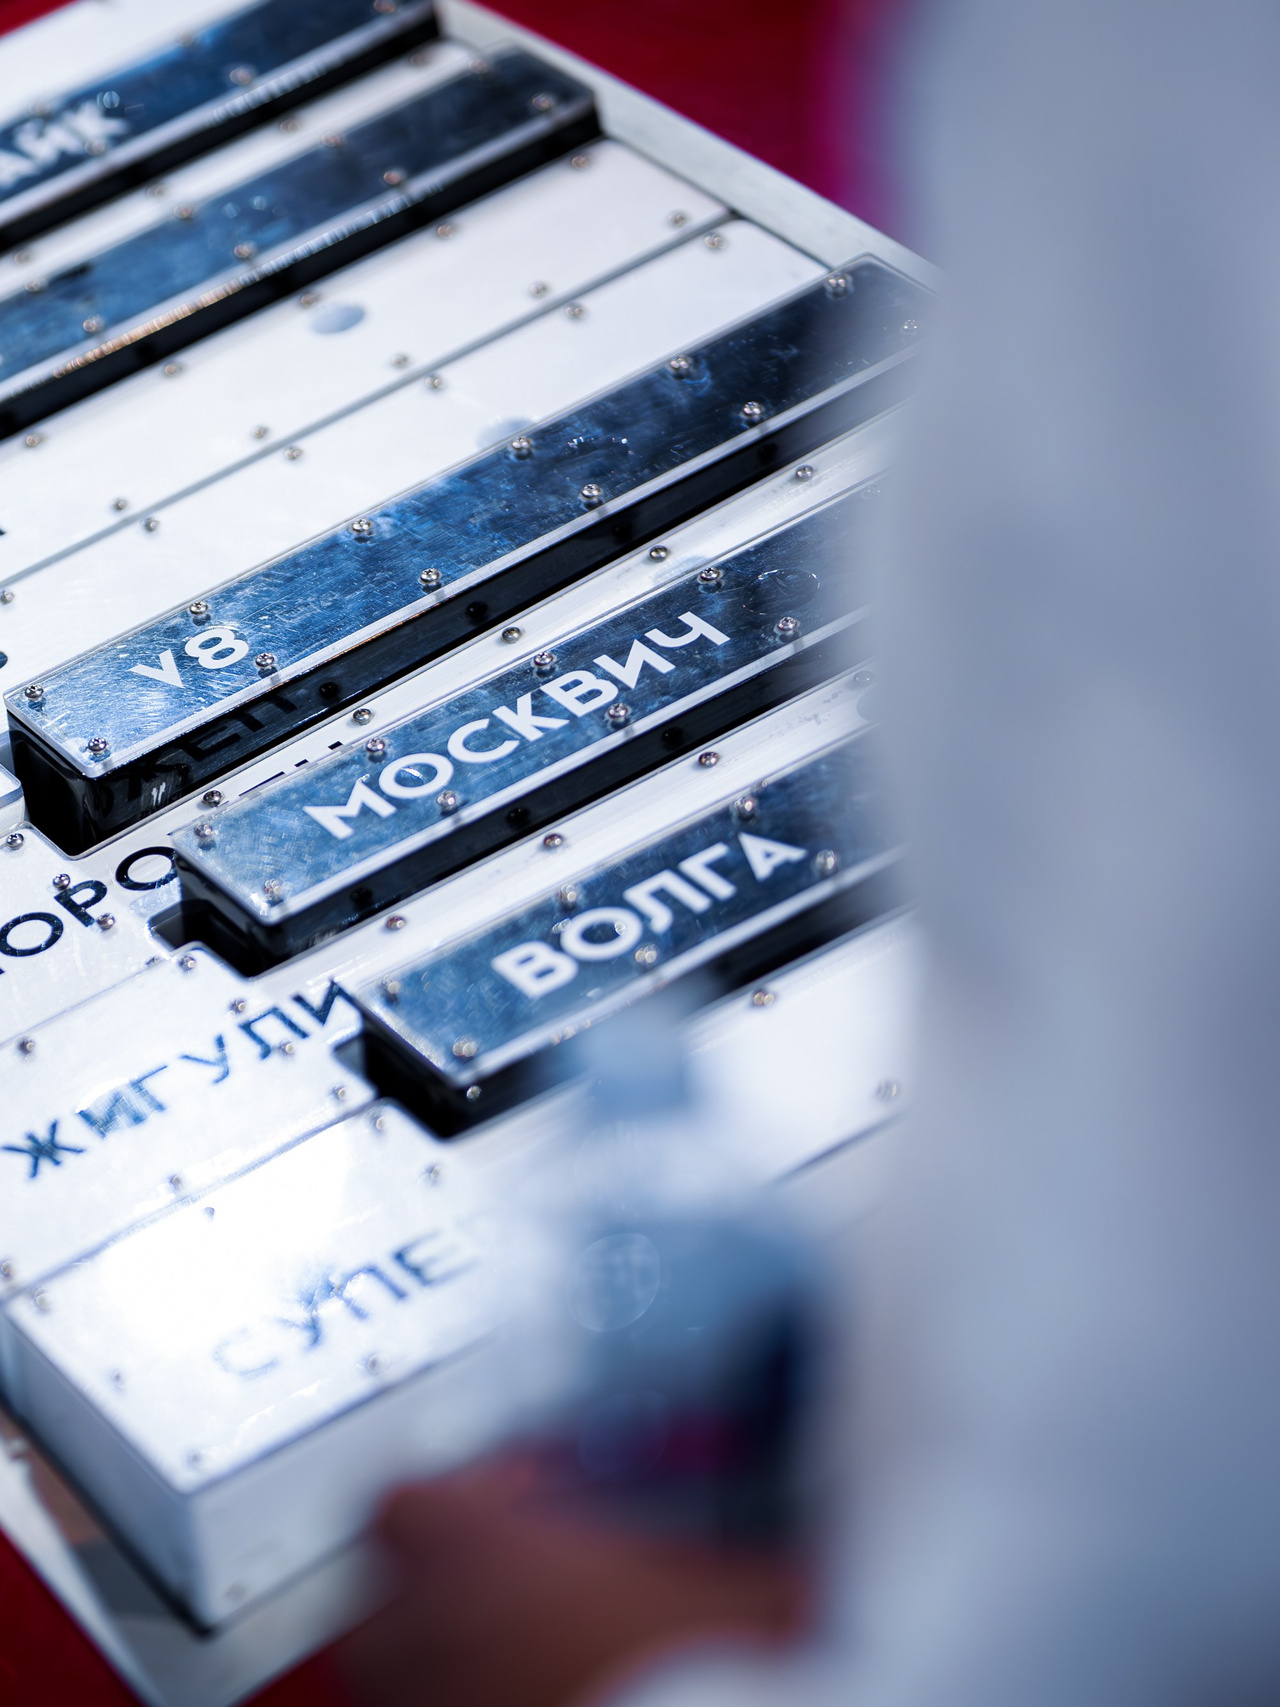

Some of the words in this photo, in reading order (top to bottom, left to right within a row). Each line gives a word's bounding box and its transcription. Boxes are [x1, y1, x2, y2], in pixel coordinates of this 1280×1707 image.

[130, 627, 249, 689] V8
[303, 611, 731, 840] МОСКВИЧ
[491, 831, 807, 998] ВОЛГА
[0, 977, 362, 1180] ЖИГУЛИ
